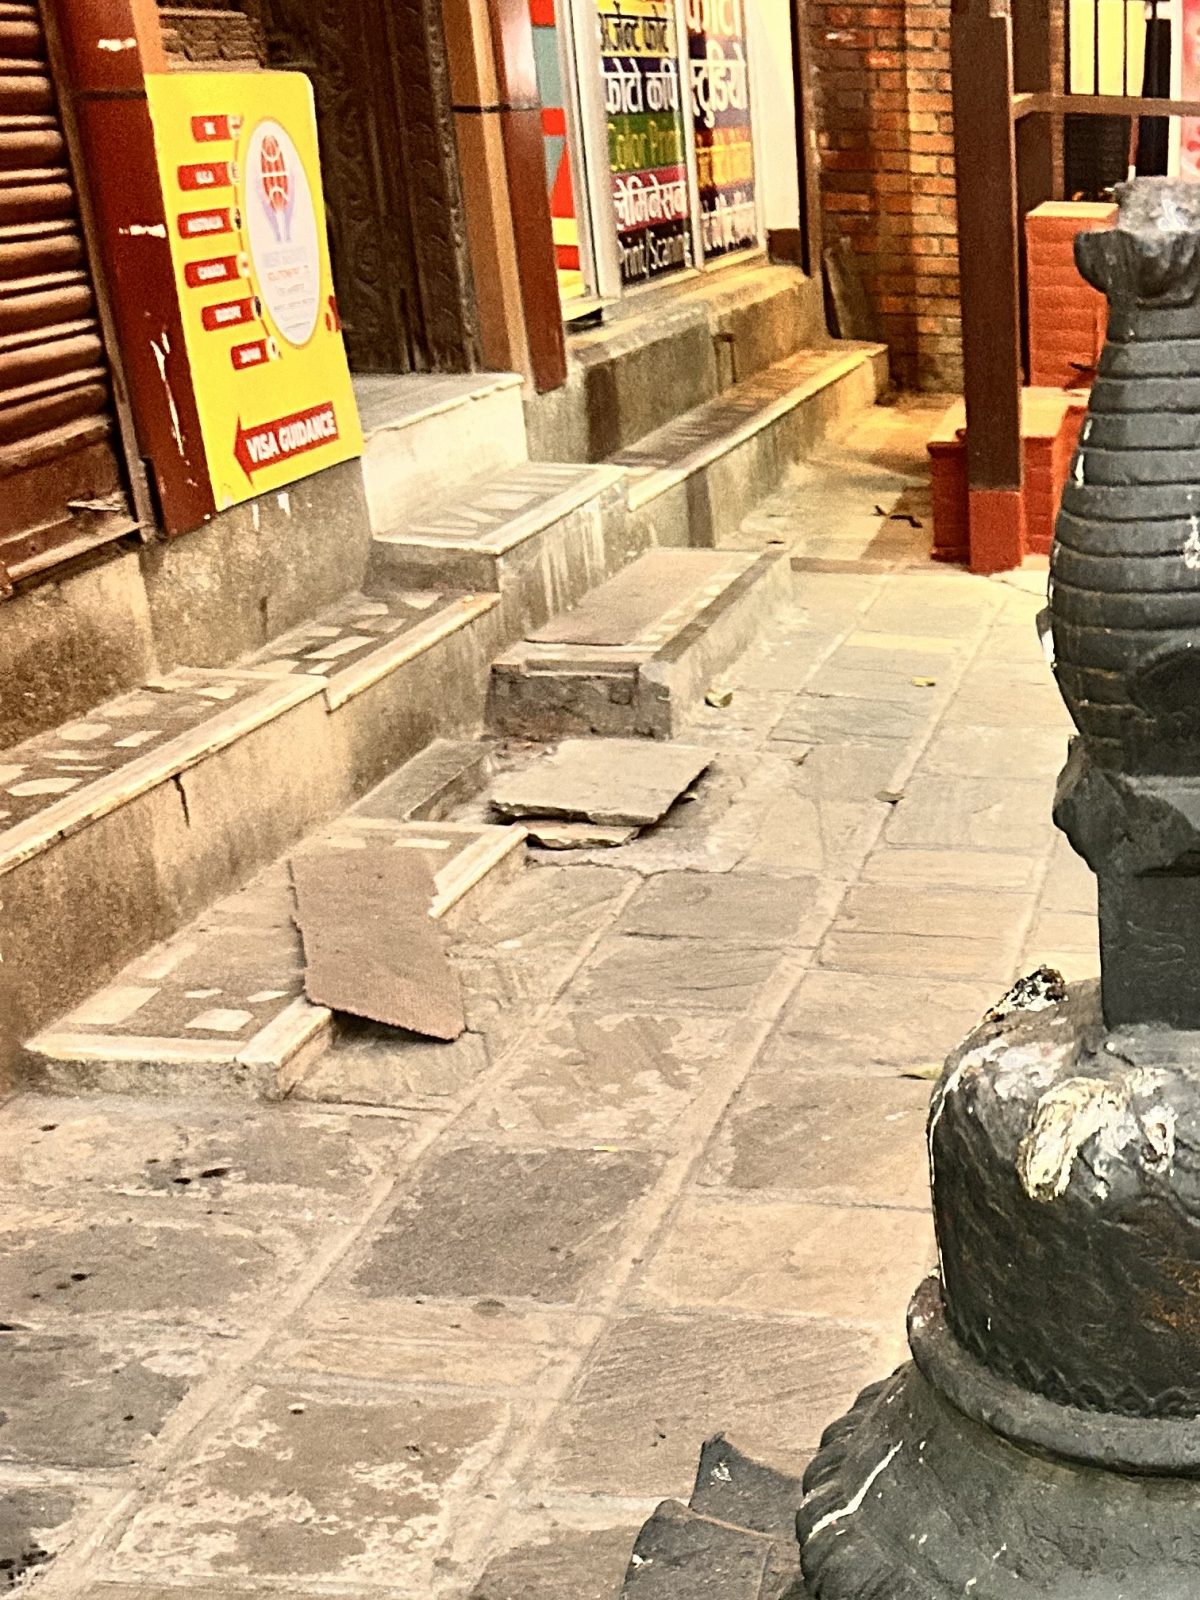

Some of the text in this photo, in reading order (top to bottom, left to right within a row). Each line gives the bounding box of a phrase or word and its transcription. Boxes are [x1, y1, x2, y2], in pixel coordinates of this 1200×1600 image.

[599, 58, 644, 115] फोटो
[245, 410, 337, 463] VISA GUIDANCE
